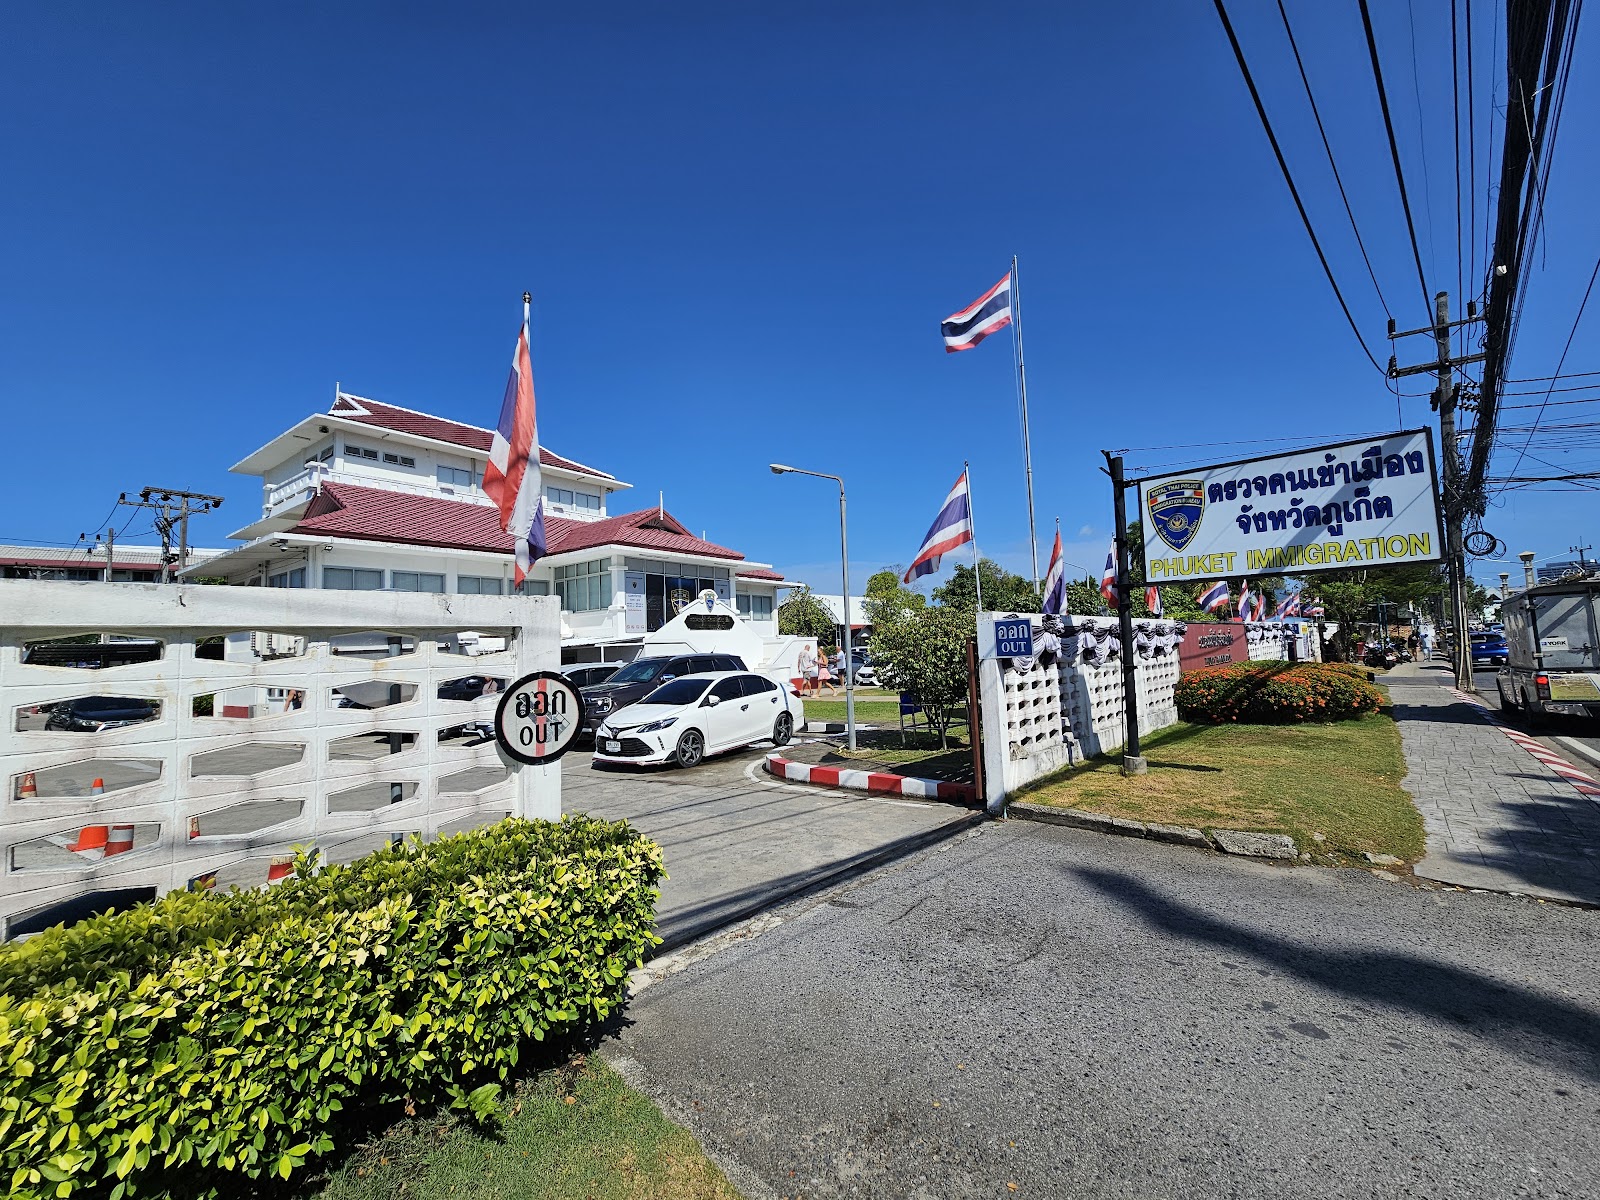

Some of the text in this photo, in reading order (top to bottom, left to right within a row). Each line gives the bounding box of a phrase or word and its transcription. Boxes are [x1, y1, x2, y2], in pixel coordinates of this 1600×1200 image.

[1207, 445, 1424, 503] ตรวจคนเข้าเมือง
[1152, 488, 1167, 496] ROYAL
[1236, 486, 1393, 536] จังหวัดภูเก็ต
[1150, 532, 1431, 578] PHUKET IMMIGRATION
[998, 625, 1028, 640] ออก
[1002, 642, 1026, 652] OUT
[516, 690, 566, 718] ออก
[520, 722, 562, 746] OUT
